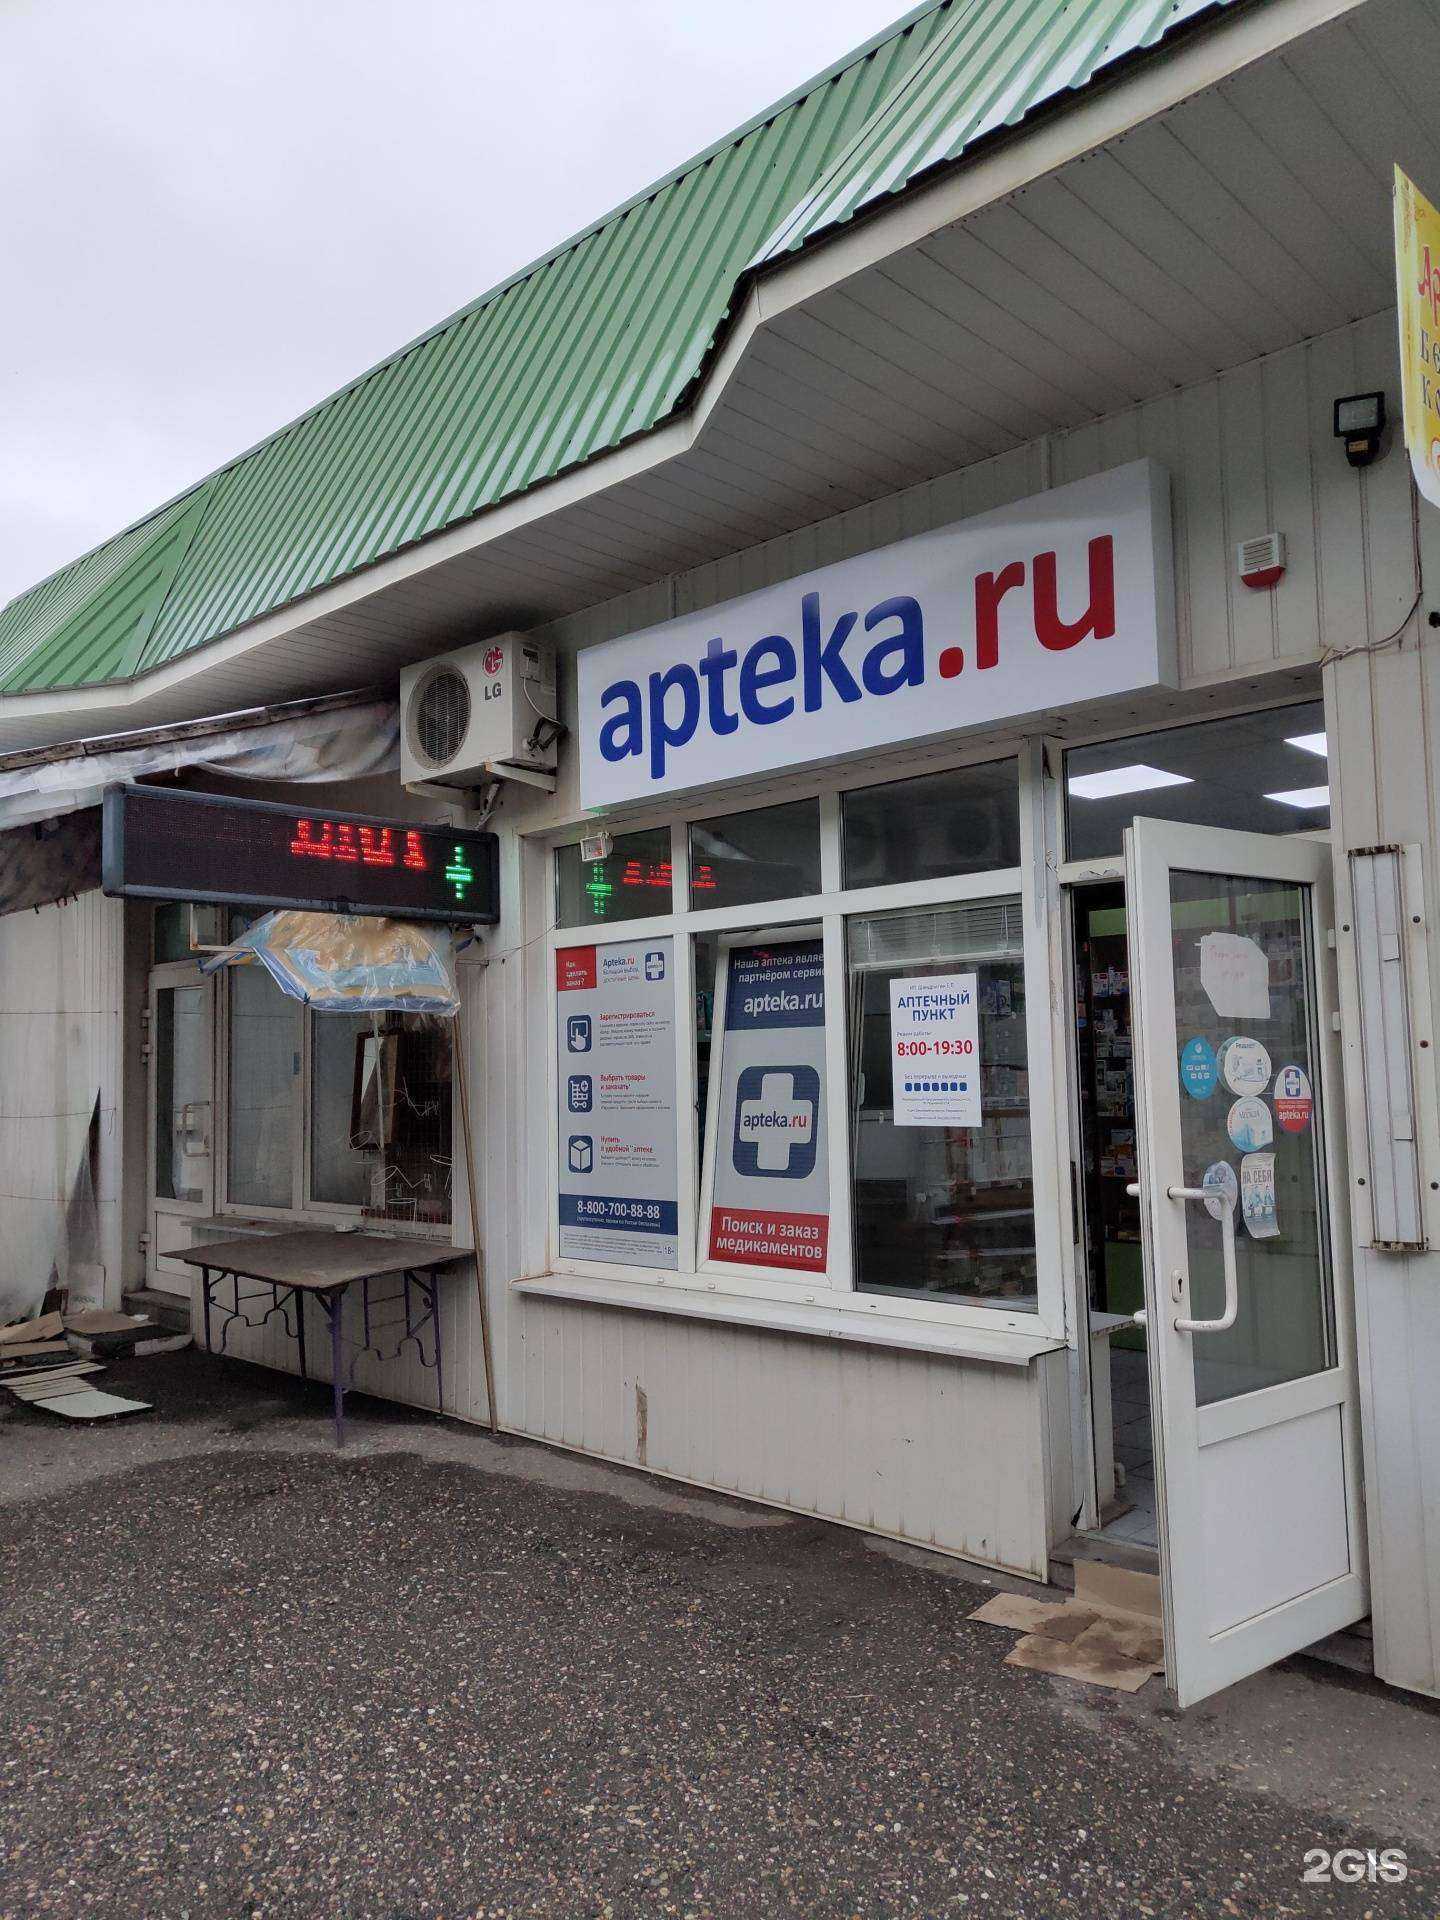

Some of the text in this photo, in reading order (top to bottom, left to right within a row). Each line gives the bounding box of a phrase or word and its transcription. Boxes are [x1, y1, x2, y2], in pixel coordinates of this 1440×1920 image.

[599, 534, 1116, 780] apteka.ru
[484, 682, 502, 700] LG
[603, 956, 635, 968] Apteka.ru
[734, 959, 759, 969] Наша
[761, 957, 793, 967] аптека
[738, 970, 791, 984] партнёром
[743, 990, 823, 1017] apteka.ru
[897, 989, 970, 1008] АПТЕЧНЫЙ
[912, 1008, 956, 1021] ПУНКТ
[897, 1039, 973, 1056] 8:00-19:30
[743, 1110, 807, 1130] apteka.ru
[1279, 1109, 1309, 1121] apteka.ru
[577, 1200, 660, 1219] 8-800-700-88-88
[721, 1216, 819, 1239] Поиск и заказ
[716, 1236, 822, 1258] медикаментов
